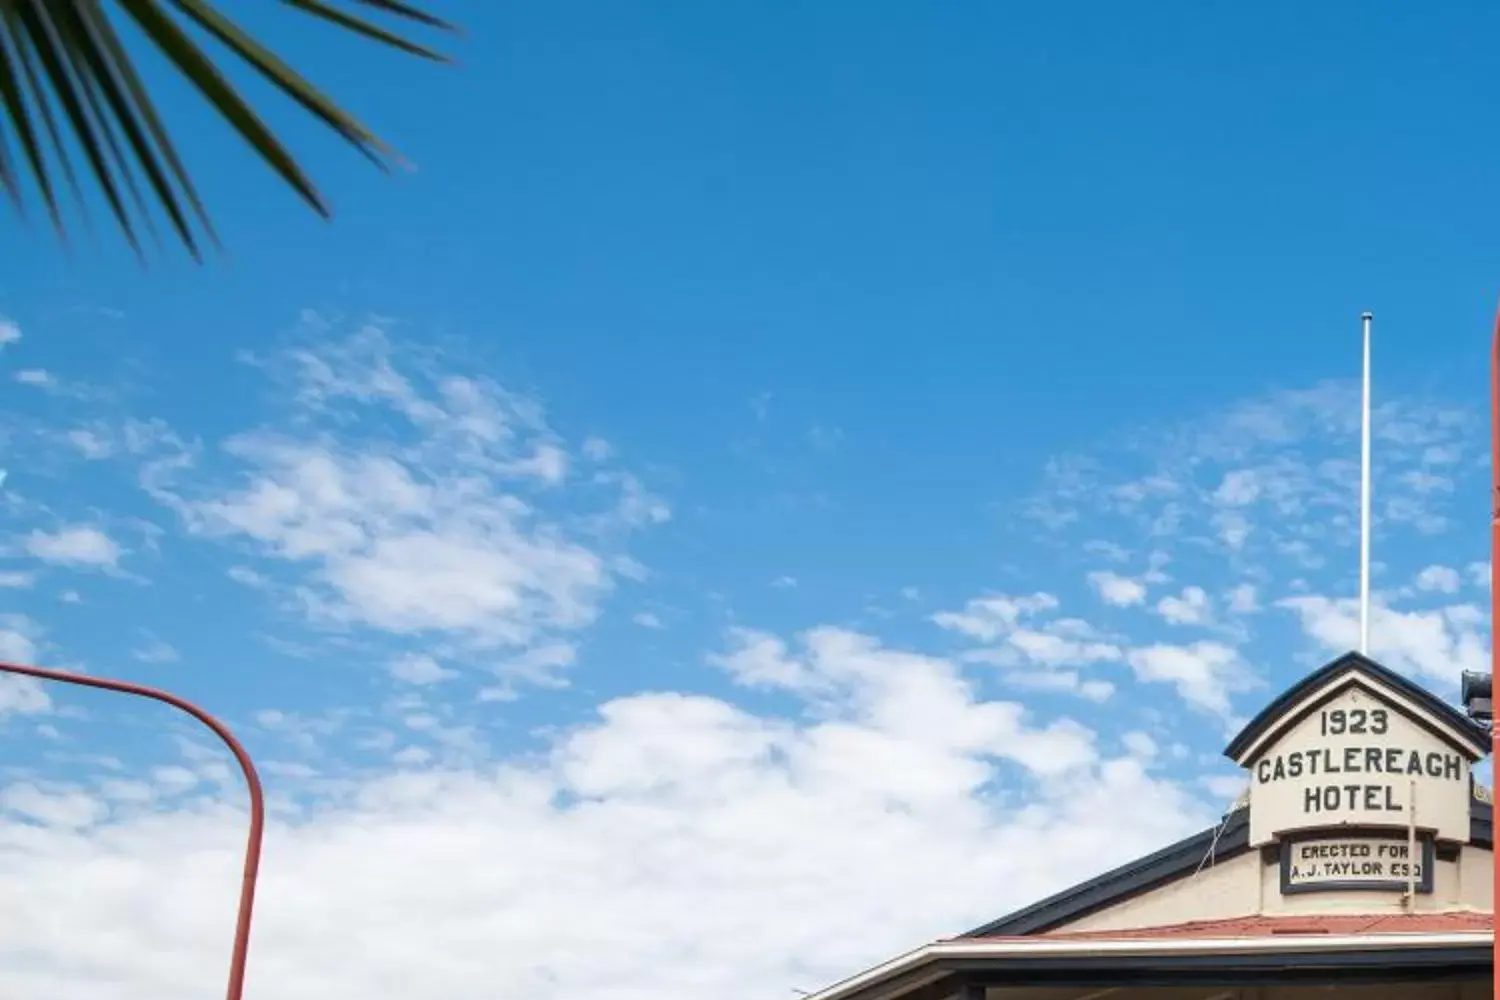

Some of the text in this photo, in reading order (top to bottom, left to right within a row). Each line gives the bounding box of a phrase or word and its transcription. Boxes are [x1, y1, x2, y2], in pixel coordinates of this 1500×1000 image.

[1320, 709, 1388, 736] 1923
[1257, 748, 1461, 784] CASTLEREAGH
[1303, 785, 1403, 812] HOTEL
[1301, 844, 1370, 859] ERECTED
[1378, 844, 1409, 858] FOR
